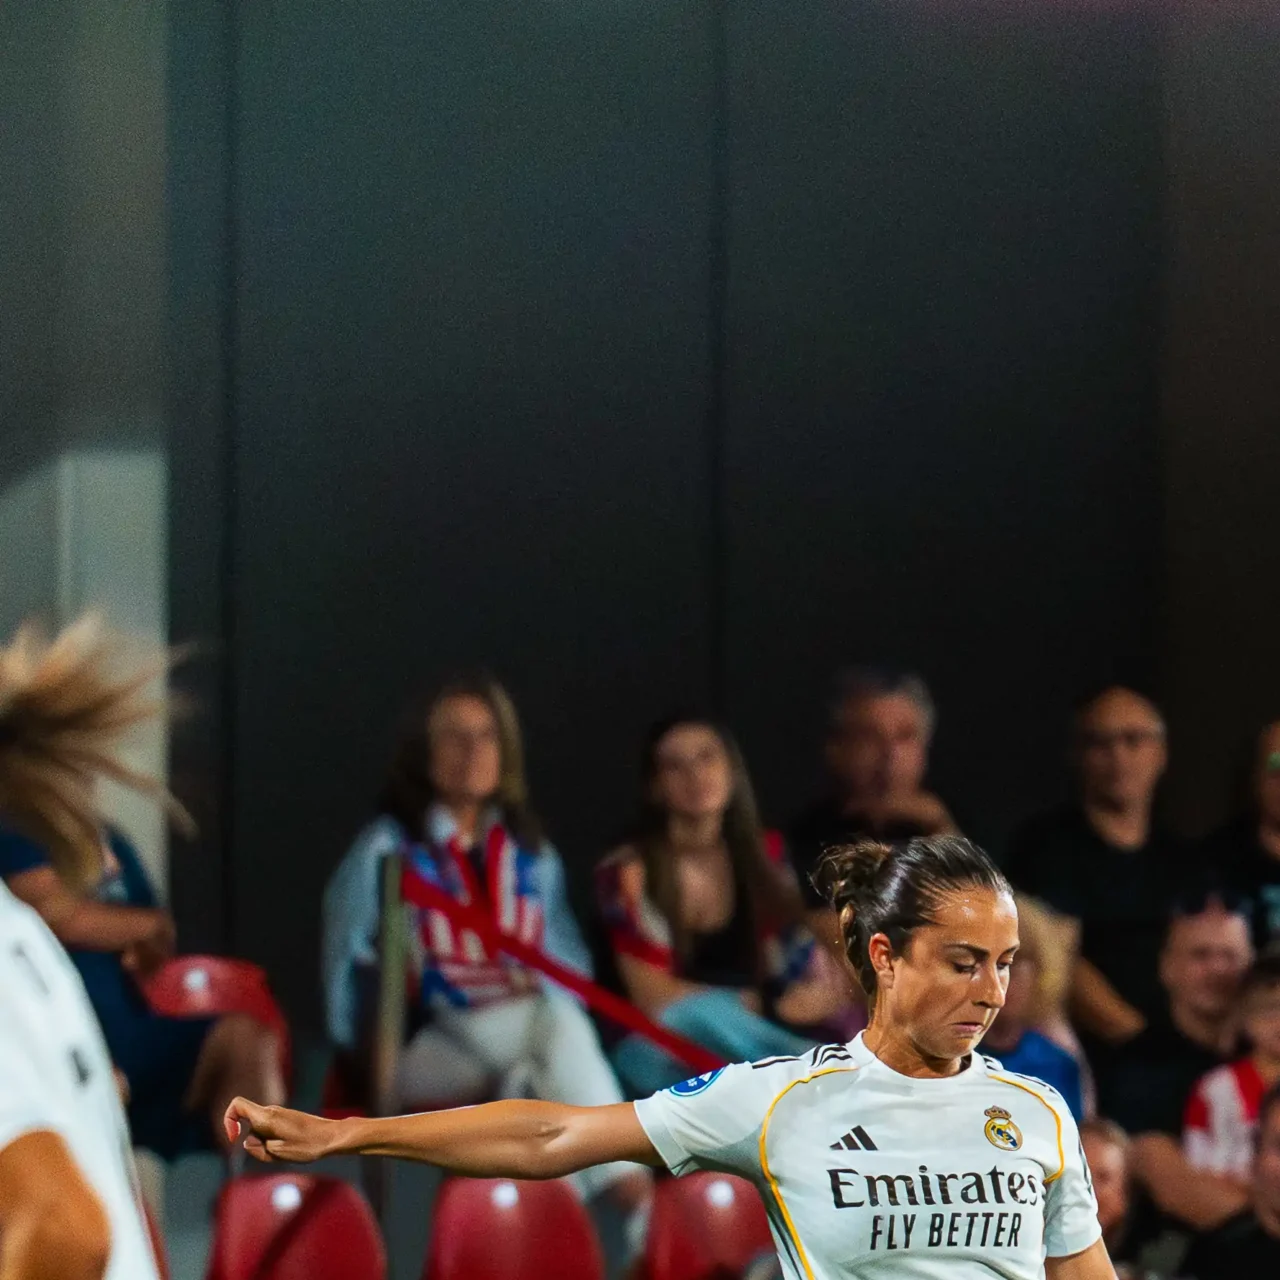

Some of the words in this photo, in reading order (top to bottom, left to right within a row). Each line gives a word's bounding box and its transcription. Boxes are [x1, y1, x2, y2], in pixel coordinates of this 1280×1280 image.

[826, 1164, 1039, 1209] Emirates
[869, 1213, 917, 1251] FLY
[927, 1212, 1023, 1248] BETTER
